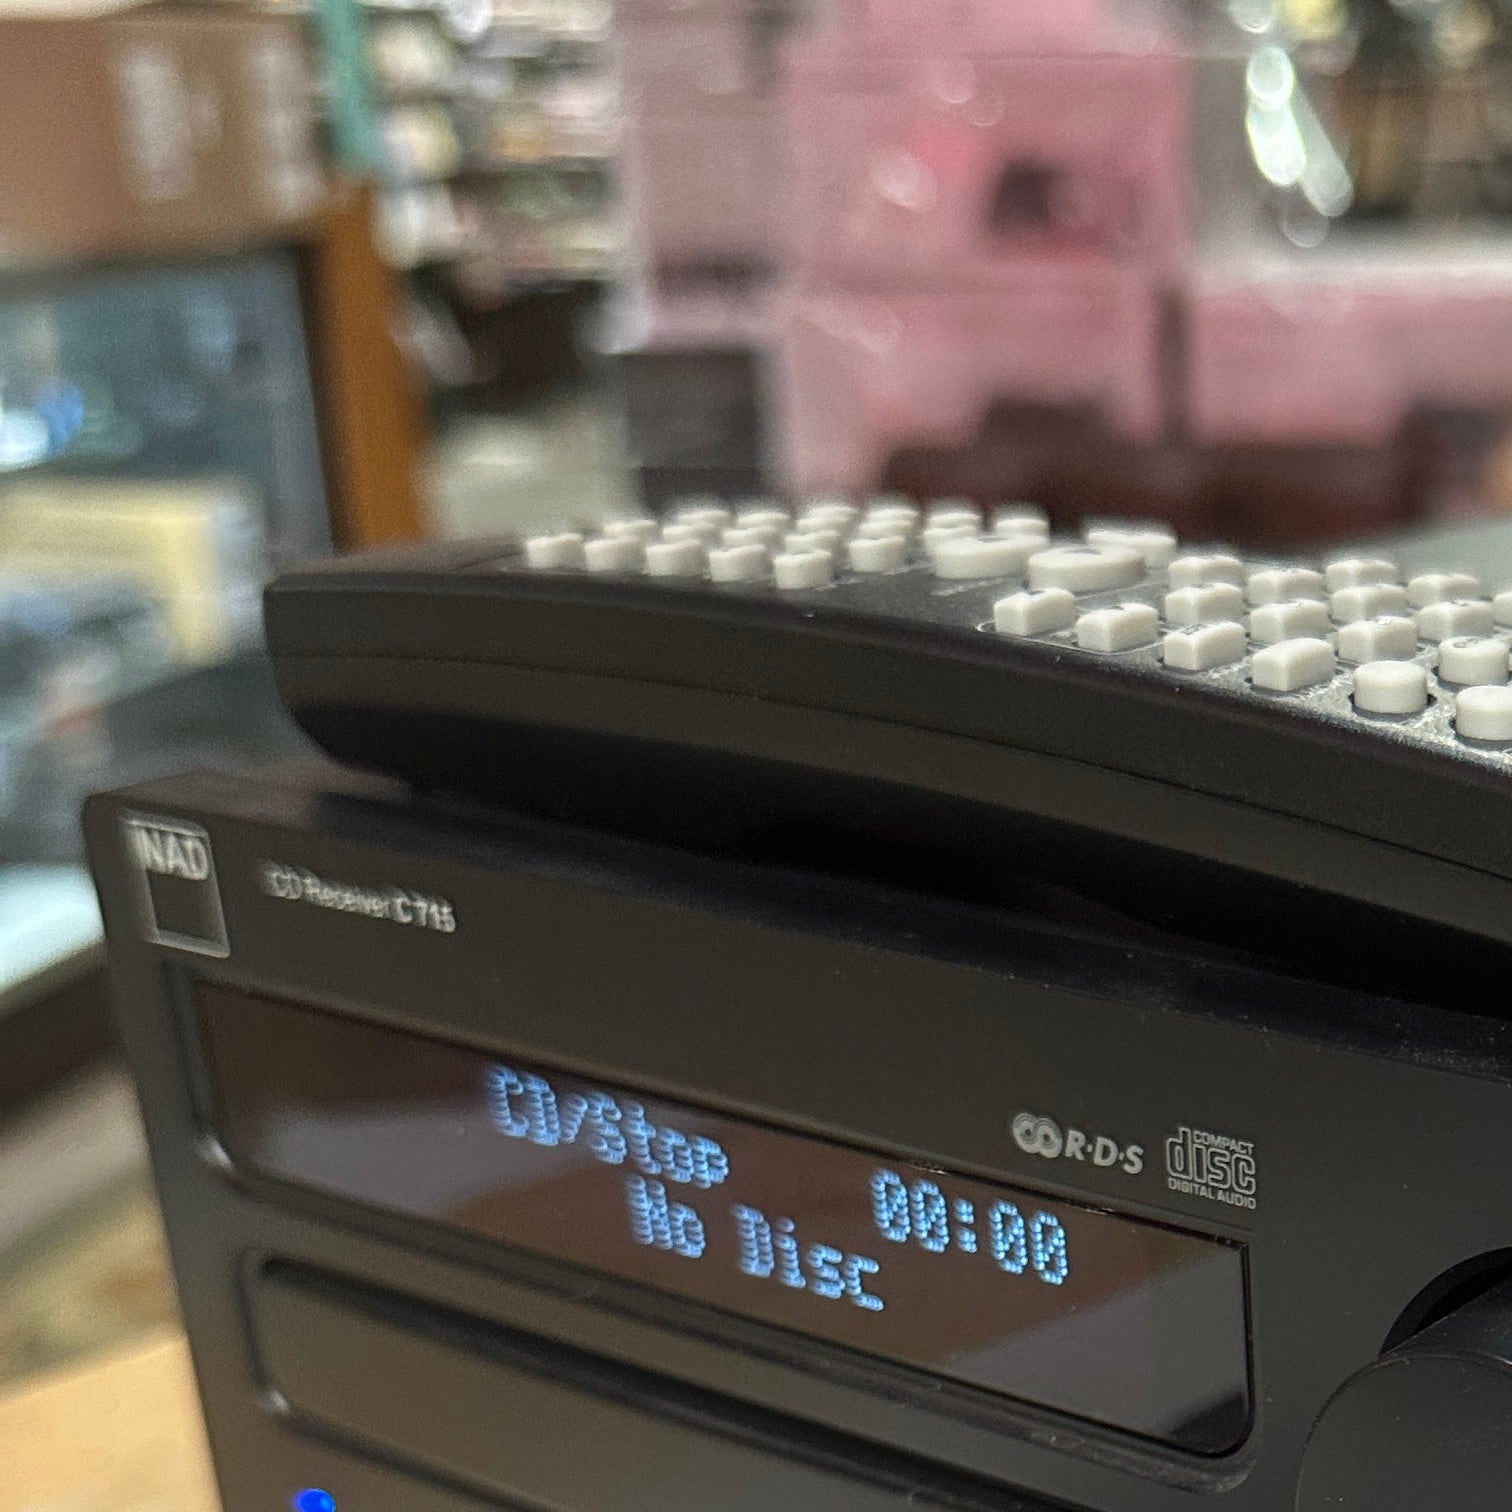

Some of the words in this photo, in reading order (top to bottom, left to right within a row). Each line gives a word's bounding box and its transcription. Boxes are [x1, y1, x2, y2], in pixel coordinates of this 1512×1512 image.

[136, 826, 210, 881] NAD
[1192, 1129, 1255, 1156] COMPACT
[484, 1064, 729, 1189] CD/Stop
[870, 1168, 1068, 1286] 00:00
[1166, 1176, 1215, 1201] DIGITAL
[1216, 1191, 1257, 1210] AUDIO
[625, 1175, 706, 1259] No
[732, 1202, 884, 1312] Disc
